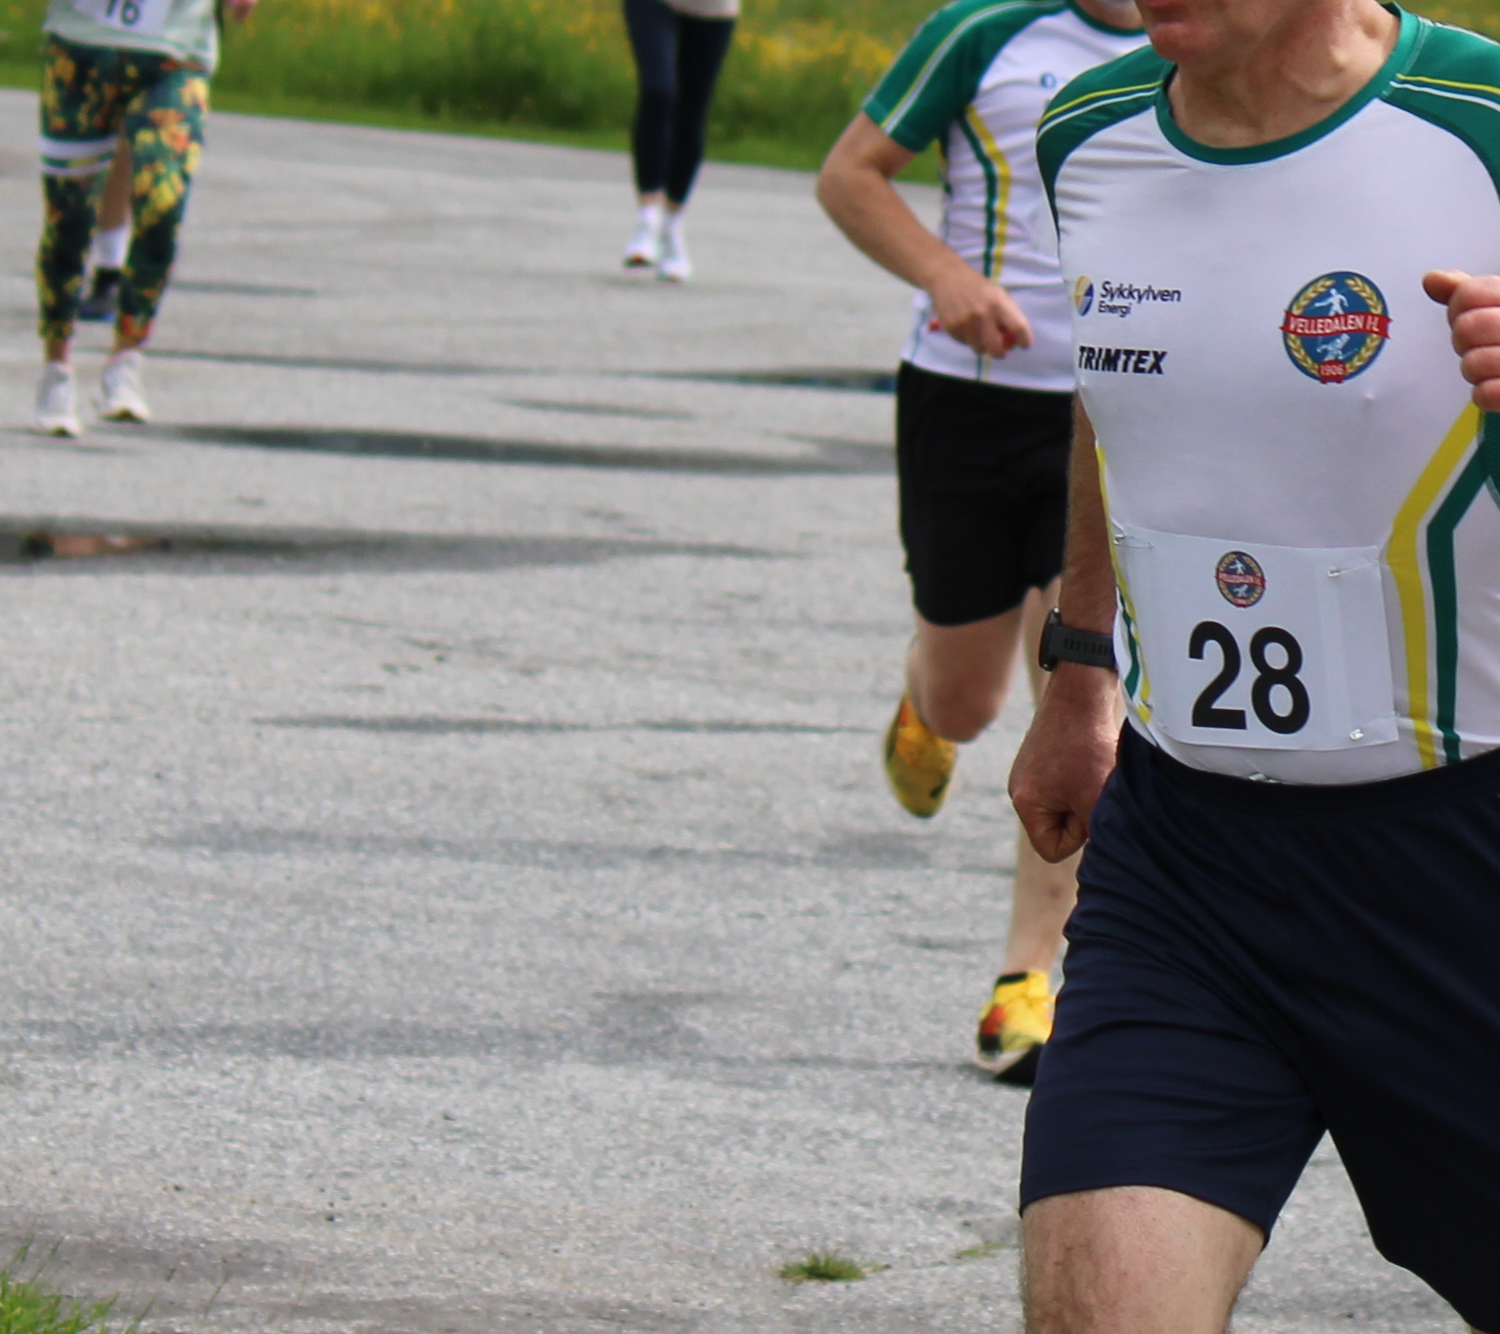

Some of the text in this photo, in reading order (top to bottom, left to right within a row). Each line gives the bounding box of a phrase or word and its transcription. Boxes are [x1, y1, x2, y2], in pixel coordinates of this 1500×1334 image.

[1100, 280, 1182, 304] Sykkylven
[1098, 300, 1133, 318] Energi
[1289, 315, 1365, 334] VELLEDALEN
[1078, 345, 1168, 375] TRIMTEX
[1189, 620, 1311, 735] 28
